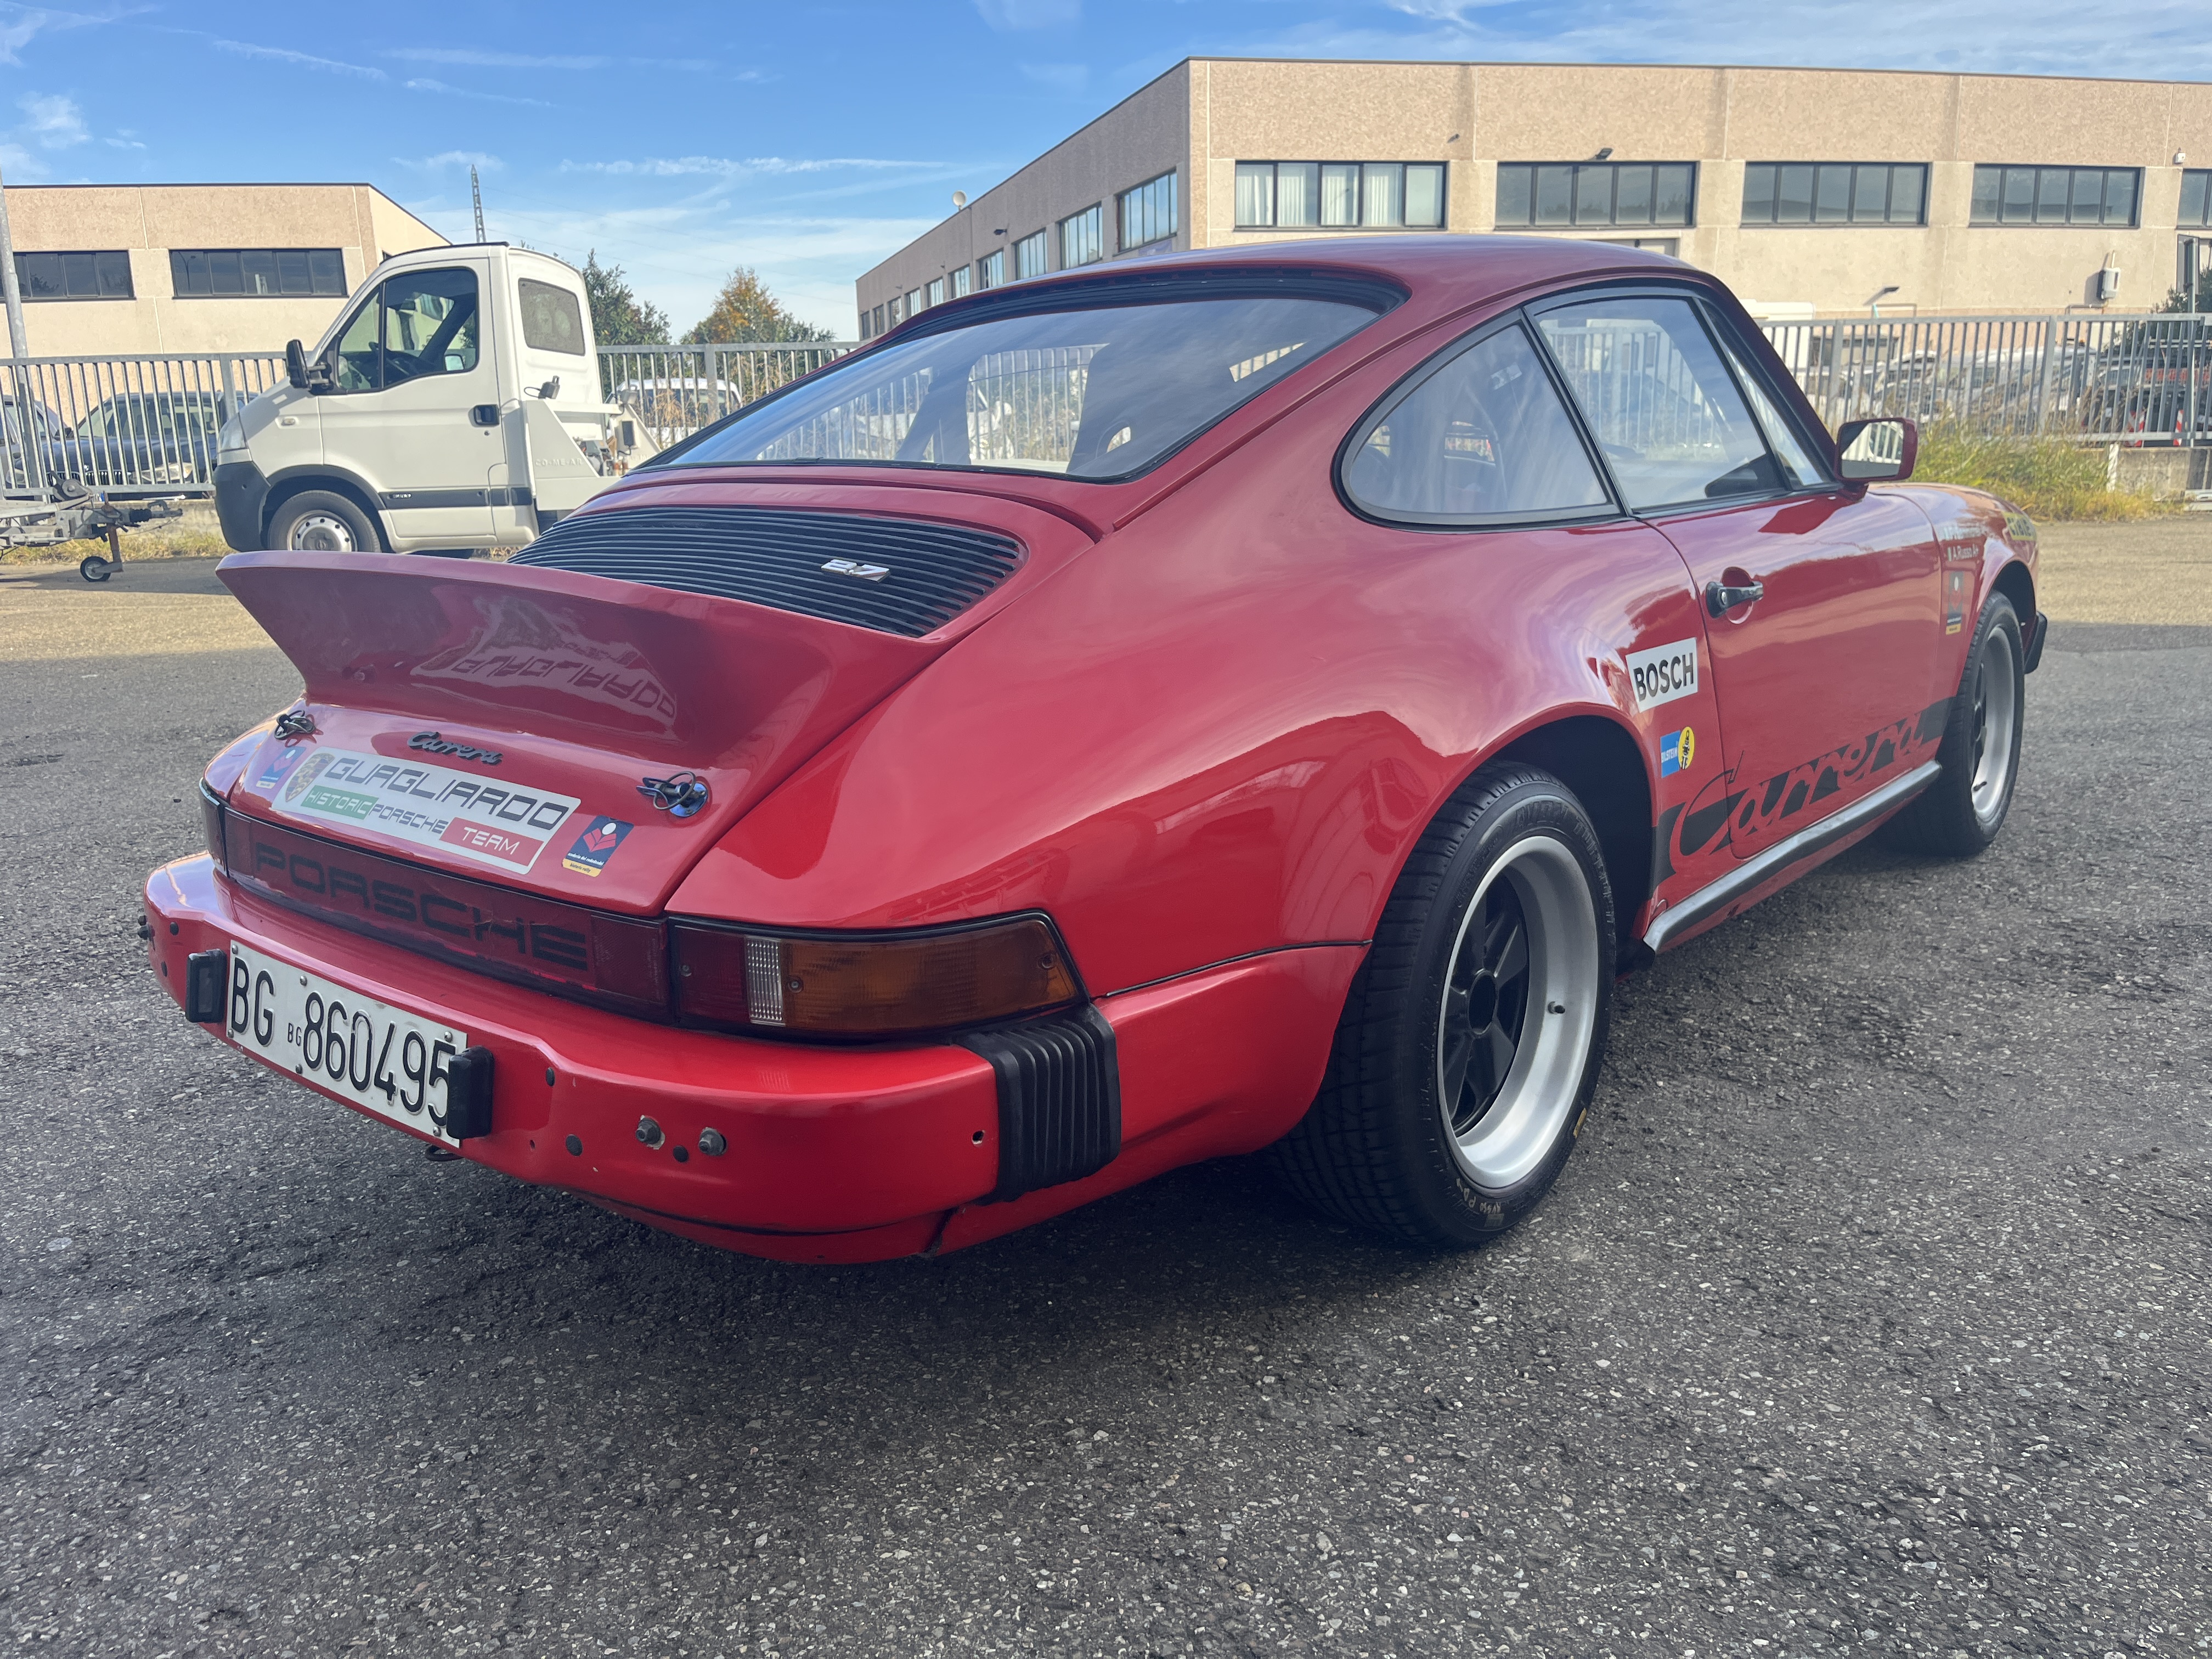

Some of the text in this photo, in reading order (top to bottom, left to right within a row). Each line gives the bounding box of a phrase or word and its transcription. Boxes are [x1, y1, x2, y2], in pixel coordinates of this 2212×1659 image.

[1633, 652, 1694, 702] BOSCH
[407, 731, 503, 765] Carrera
[305, 790, 520, 855] HISTORIC PORSCHE TEAM
[324, 758, 569, 831] GUAGLIARDO
[1669, 713, 1927, 873] Carrera
[254, 842, 589, 972] PORSCHE
[230, 957, 456, 1127] BG BG 860495
